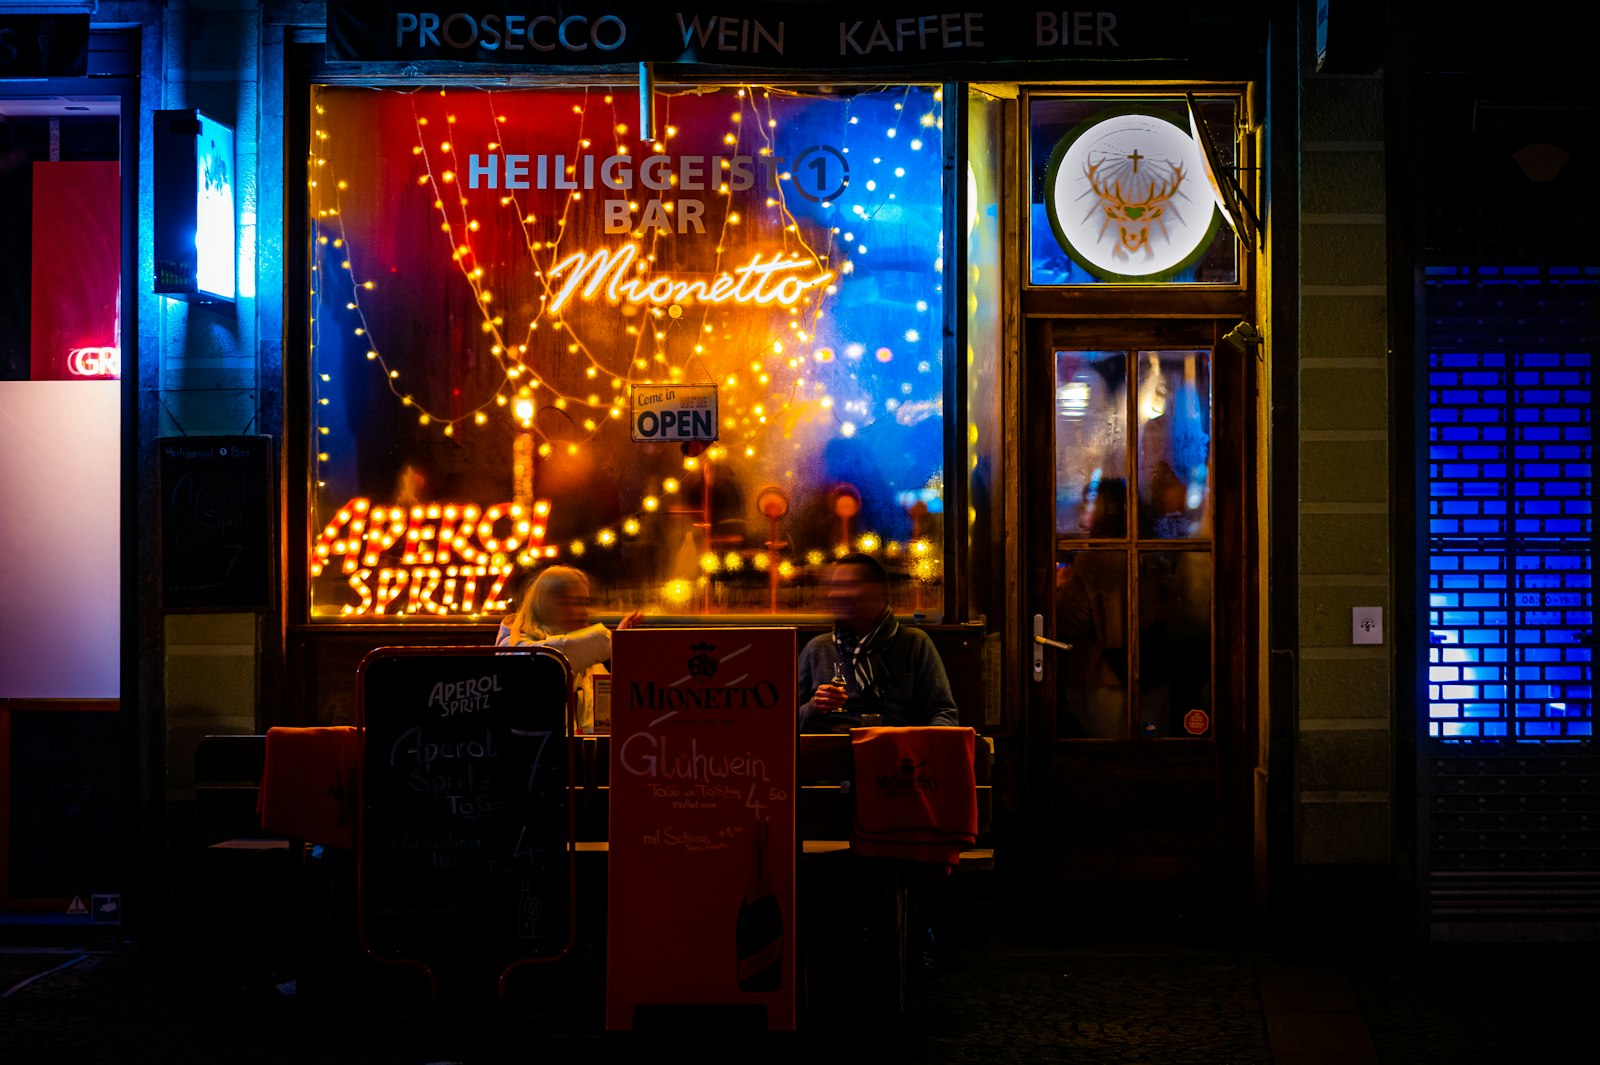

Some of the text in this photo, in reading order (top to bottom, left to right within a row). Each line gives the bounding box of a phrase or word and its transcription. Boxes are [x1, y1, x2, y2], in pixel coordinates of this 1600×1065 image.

[396, 10, 1120, 56] PROSECCO WEIN KAFFEE BIER
[468, 153, 785, 191] HEILIGGEIST
[603, 199, 707, 234] BAR
[548, 243, 834, 313] Mionetto
[637, 389, 676, 407] Come in
[637, 410, 712, 437] OPEN
[311, 497, 559, 575] APEROL
[427, 673, 503, 708] APEROL
[625, 679, 779, 710] MIONETTO
[388, 725, 497, 775] Aperol
[619, 730, 770, 783] Glühwein
